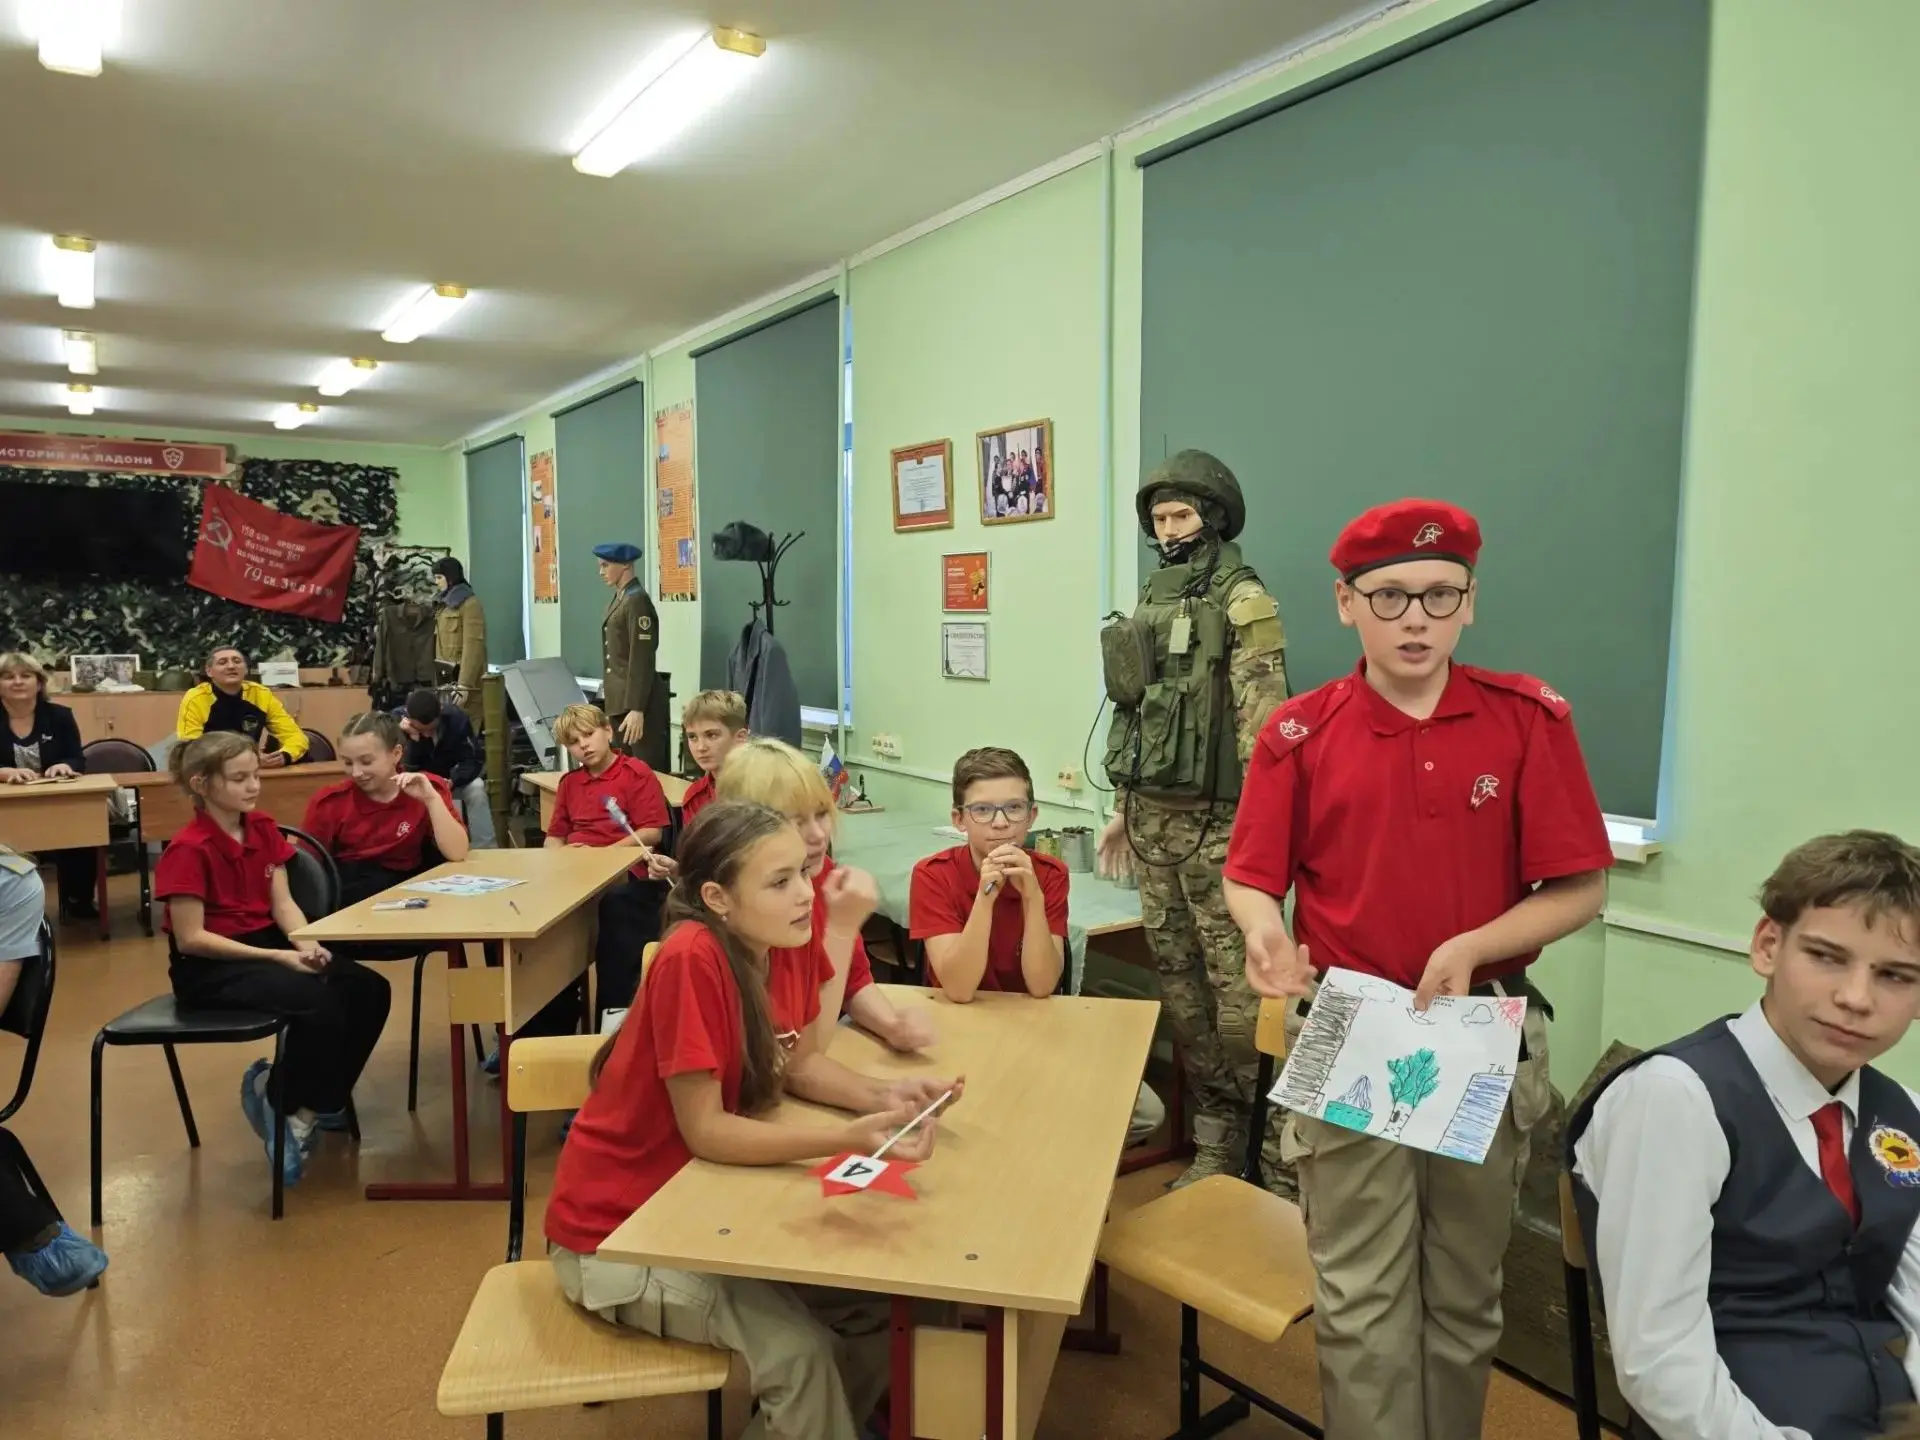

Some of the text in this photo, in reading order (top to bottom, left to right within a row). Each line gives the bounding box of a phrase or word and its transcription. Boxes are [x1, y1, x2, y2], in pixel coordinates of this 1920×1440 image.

[70, 451, 90, 462] НА
[95, 452, 153, 465] ЛАДОНИ
[242, 563, 263, 582] 79
[841, 1162, 873, 1177] 4
